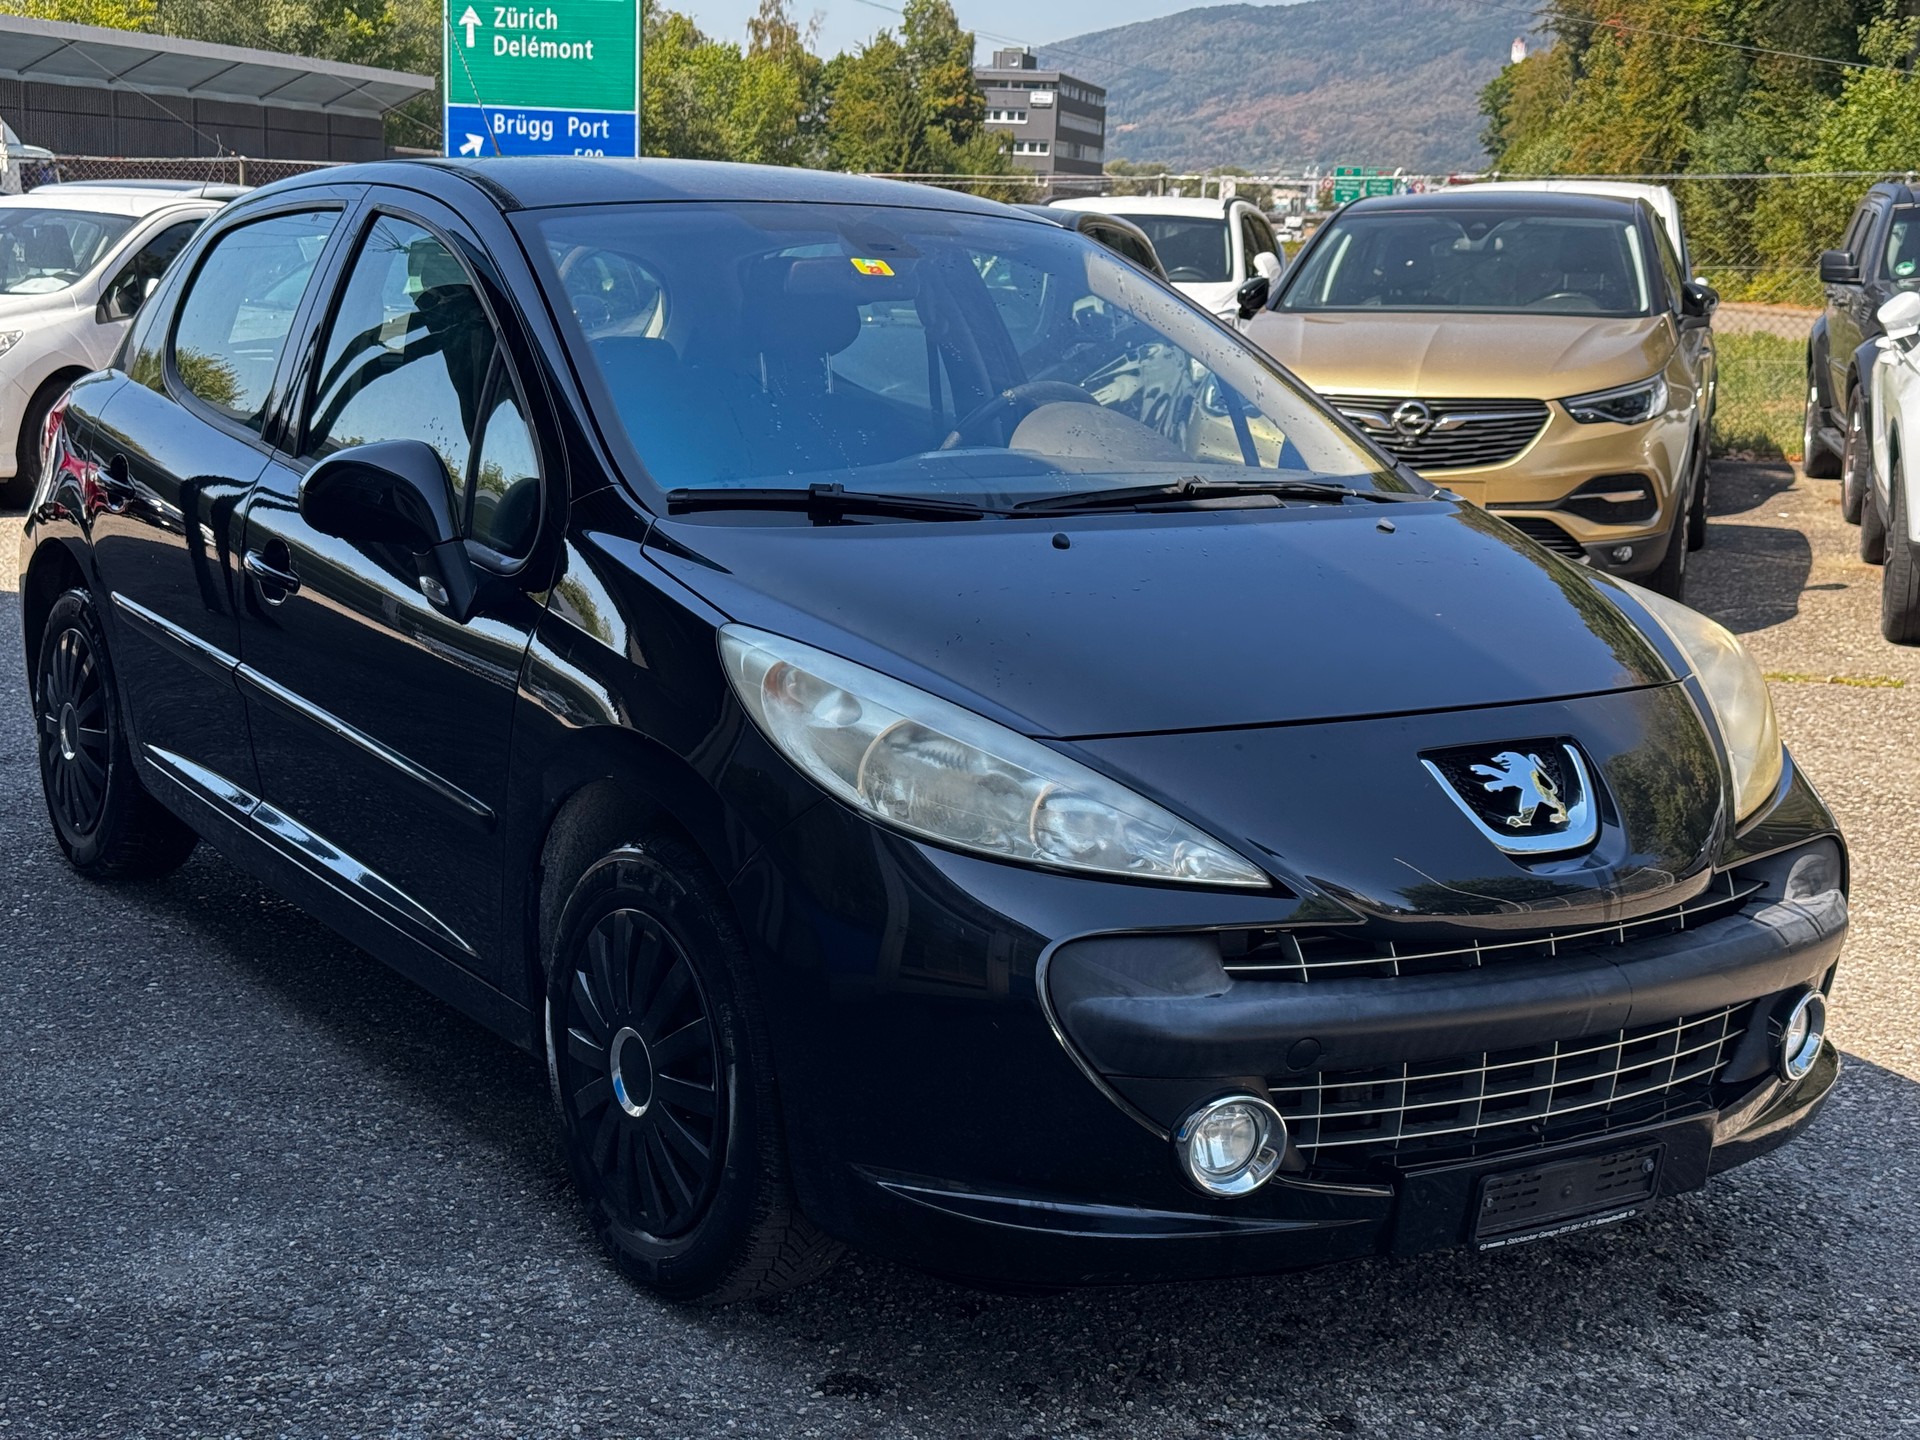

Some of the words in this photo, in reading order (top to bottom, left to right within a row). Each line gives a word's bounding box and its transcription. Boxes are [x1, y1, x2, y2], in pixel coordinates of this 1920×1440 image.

[494, 6, 558, 30] Zürich
[494, 34, 594, 60] Delémont
[494, 113, 554, 141] Brügg
[567, 116, 610, 139] Port
